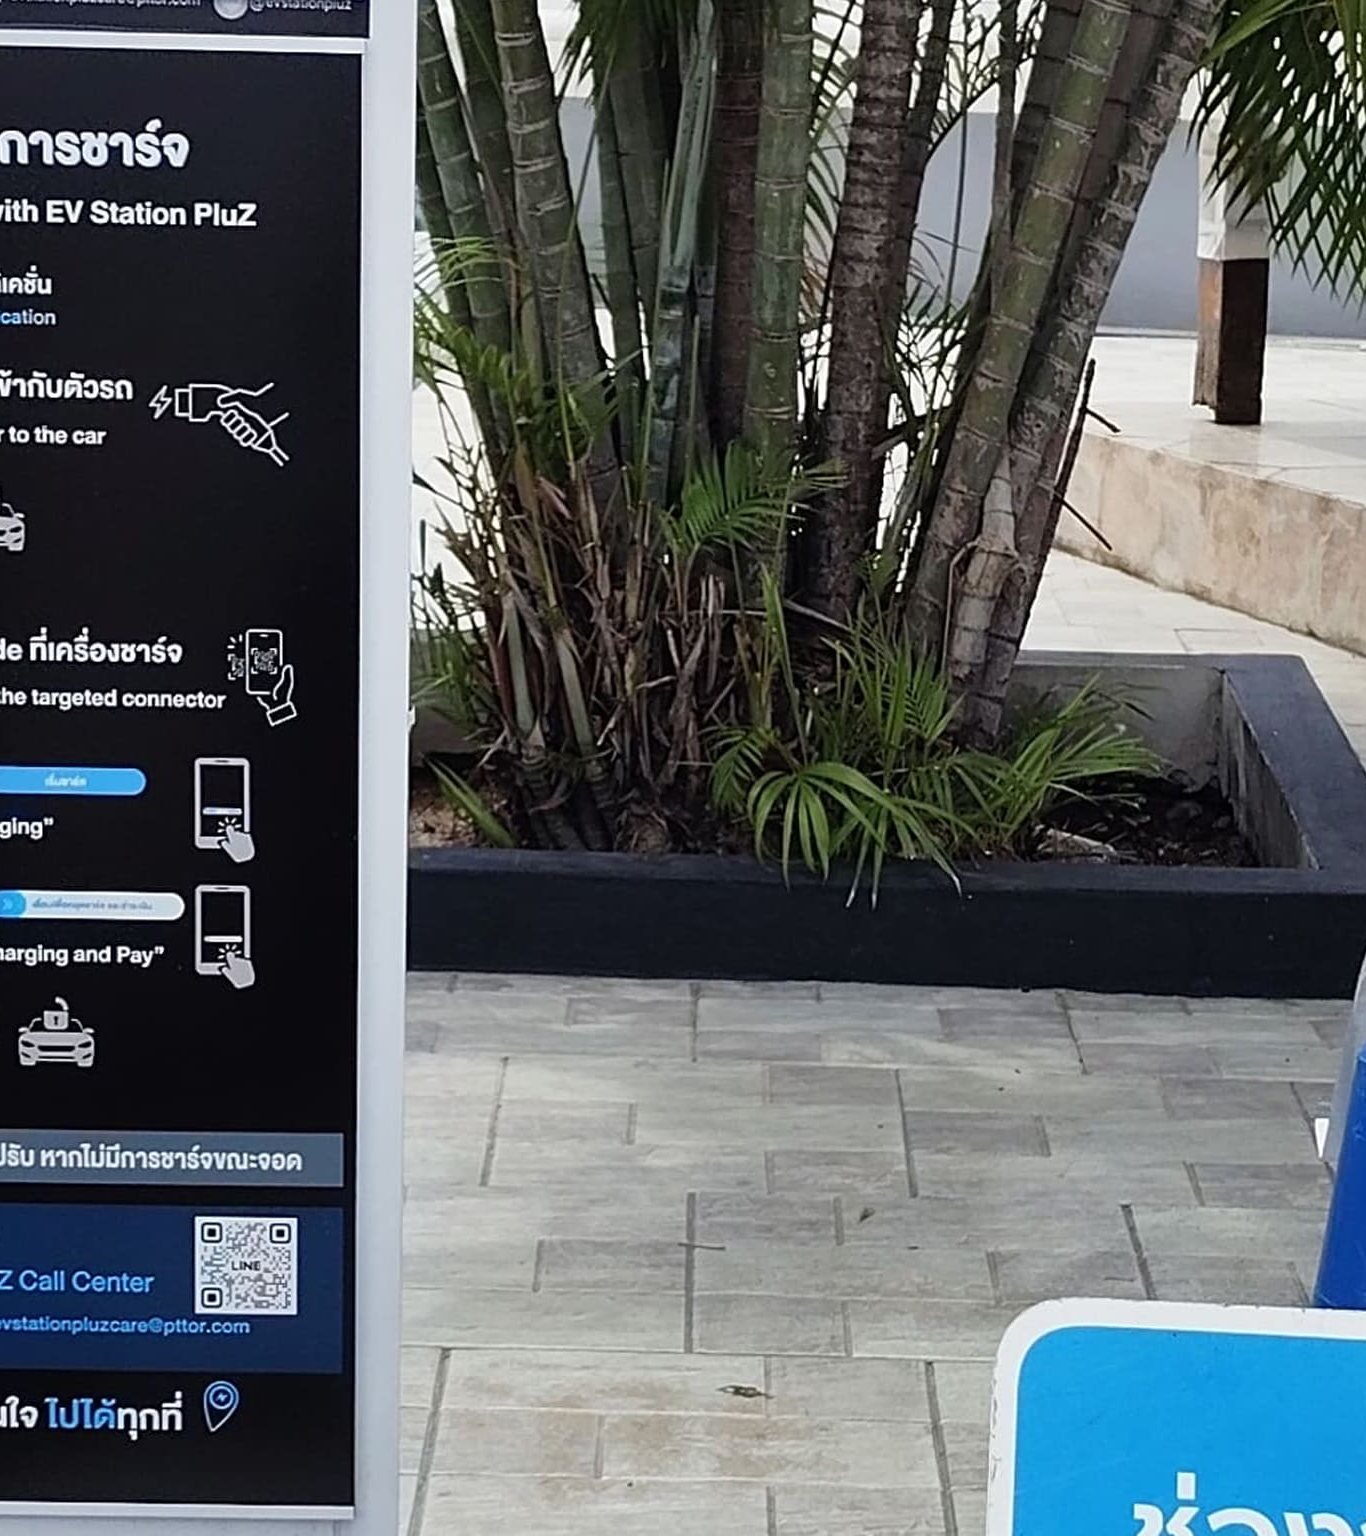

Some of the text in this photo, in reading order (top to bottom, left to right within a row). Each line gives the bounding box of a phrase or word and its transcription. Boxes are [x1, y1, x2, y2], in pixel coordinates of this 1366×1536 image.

[47, 200, 83, 223] EV
[90, 200, 186, 225] Station
[195, 203, 256, 226] PluZ
[9, 427, 29, 442] to
[34, 426, 67, 444] the
[73, 431, 106, 444] car
[30, 627, 182, 663] ที่เครื่องชาร์จ
[32, 689, 117, 710] targeted
[122, 692, 226, 708] connector
[73, 946, 111, 962] and
[117, 946, 164, 967] Pay”
[41, 1144, 301, 1170] หากไม่มีการชาร์จขณะจอด
[232, 1261, 261, 1271] LINE
[19, 1270, 64, 1291] Call
[72, 1271, 154, 1292] Center
[45, 1391, 182, 1440] ไปได้ทุกที่
